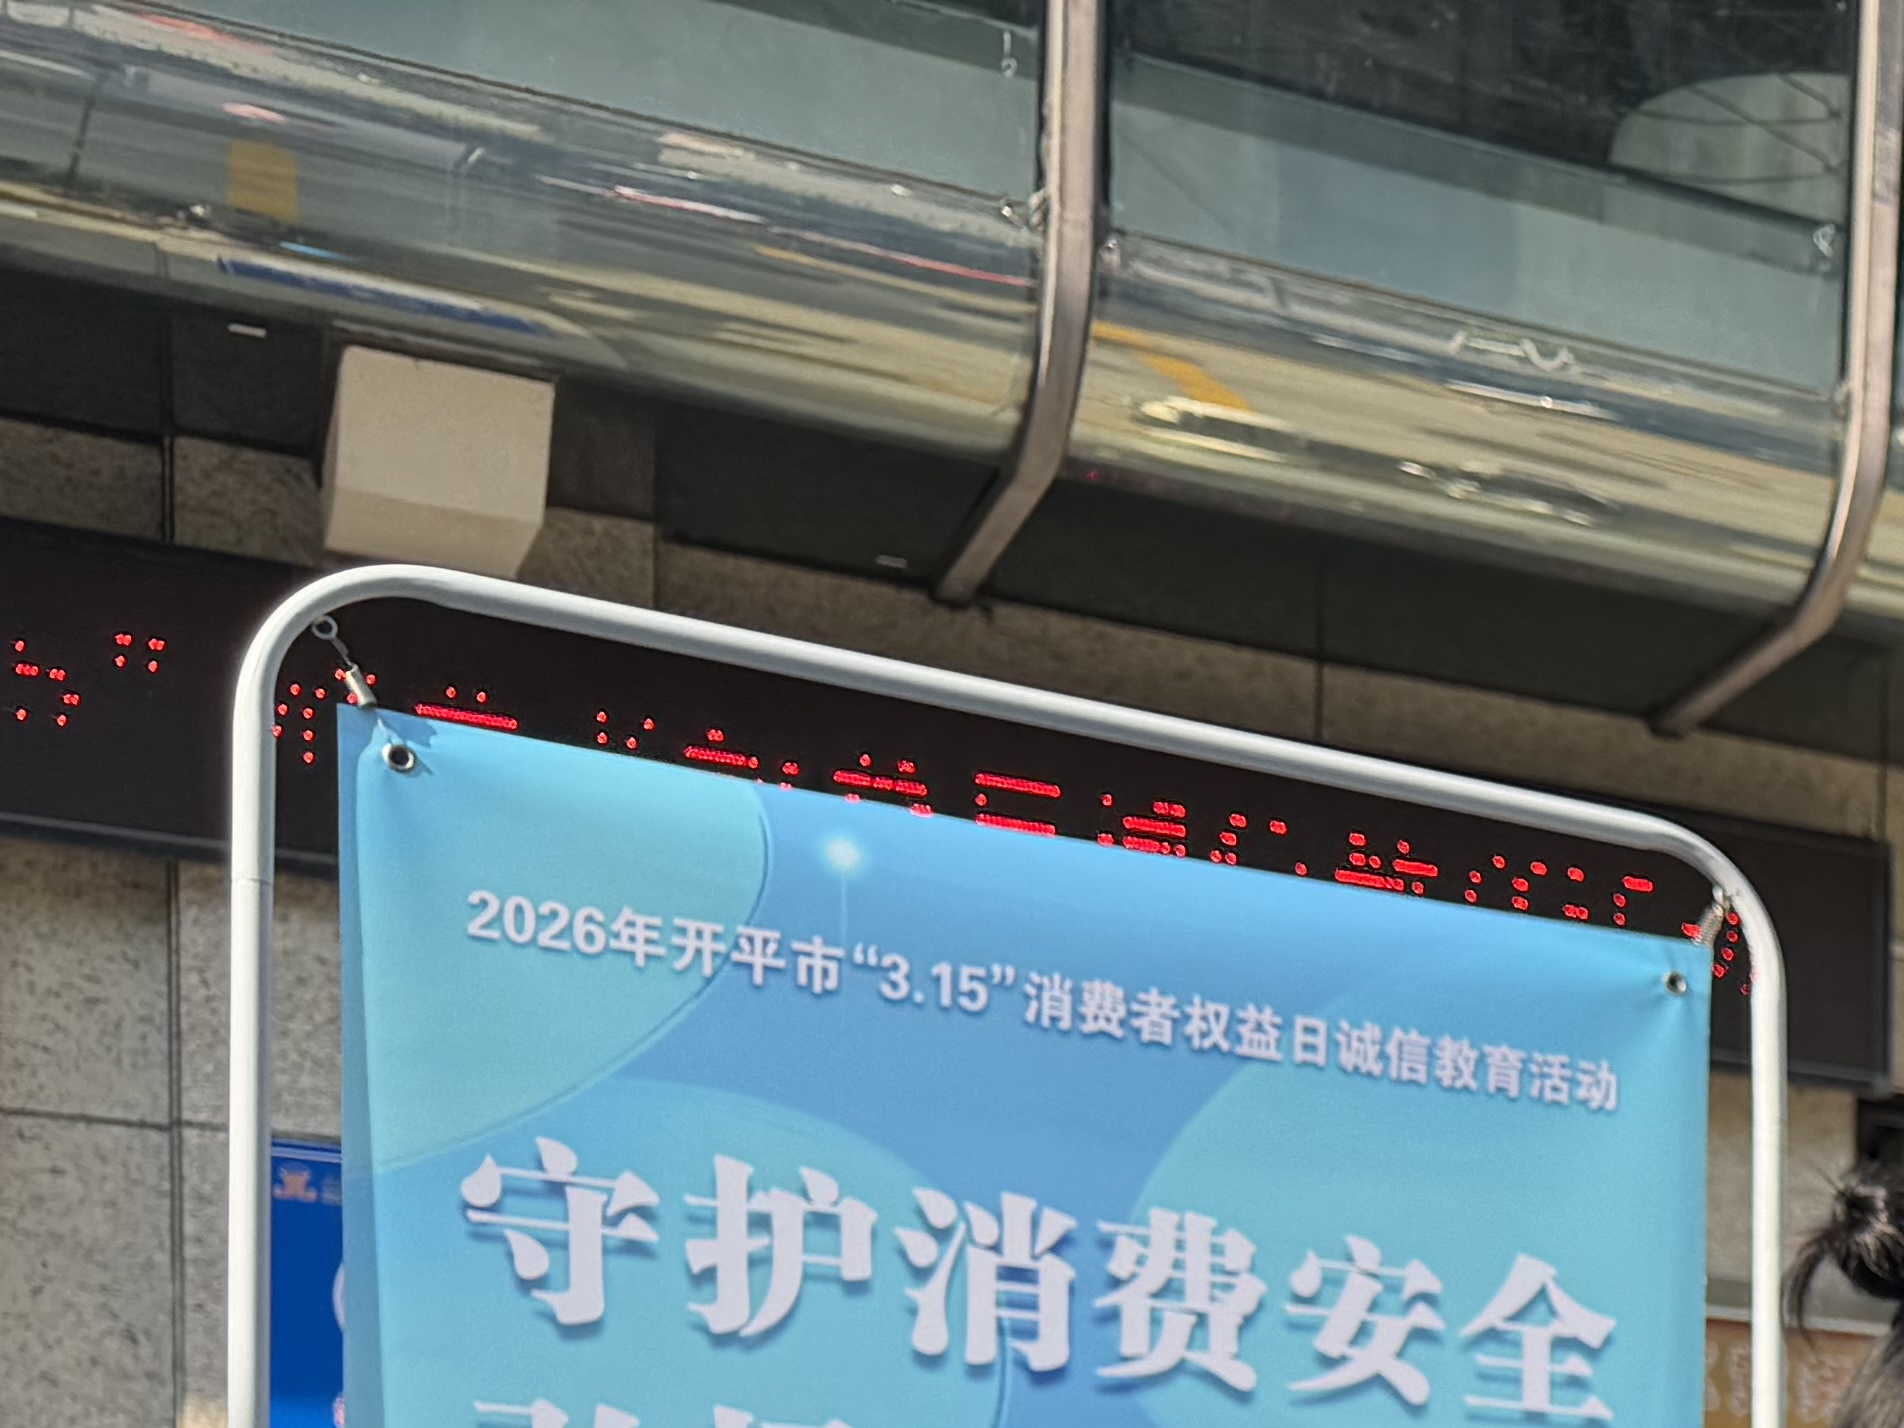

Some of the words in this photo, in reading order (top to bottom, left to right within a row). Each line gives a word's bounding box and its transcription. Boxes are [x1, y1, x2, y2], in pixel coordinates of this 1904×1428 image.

[460, 1136, 1617, 1422] 守护消费安全
